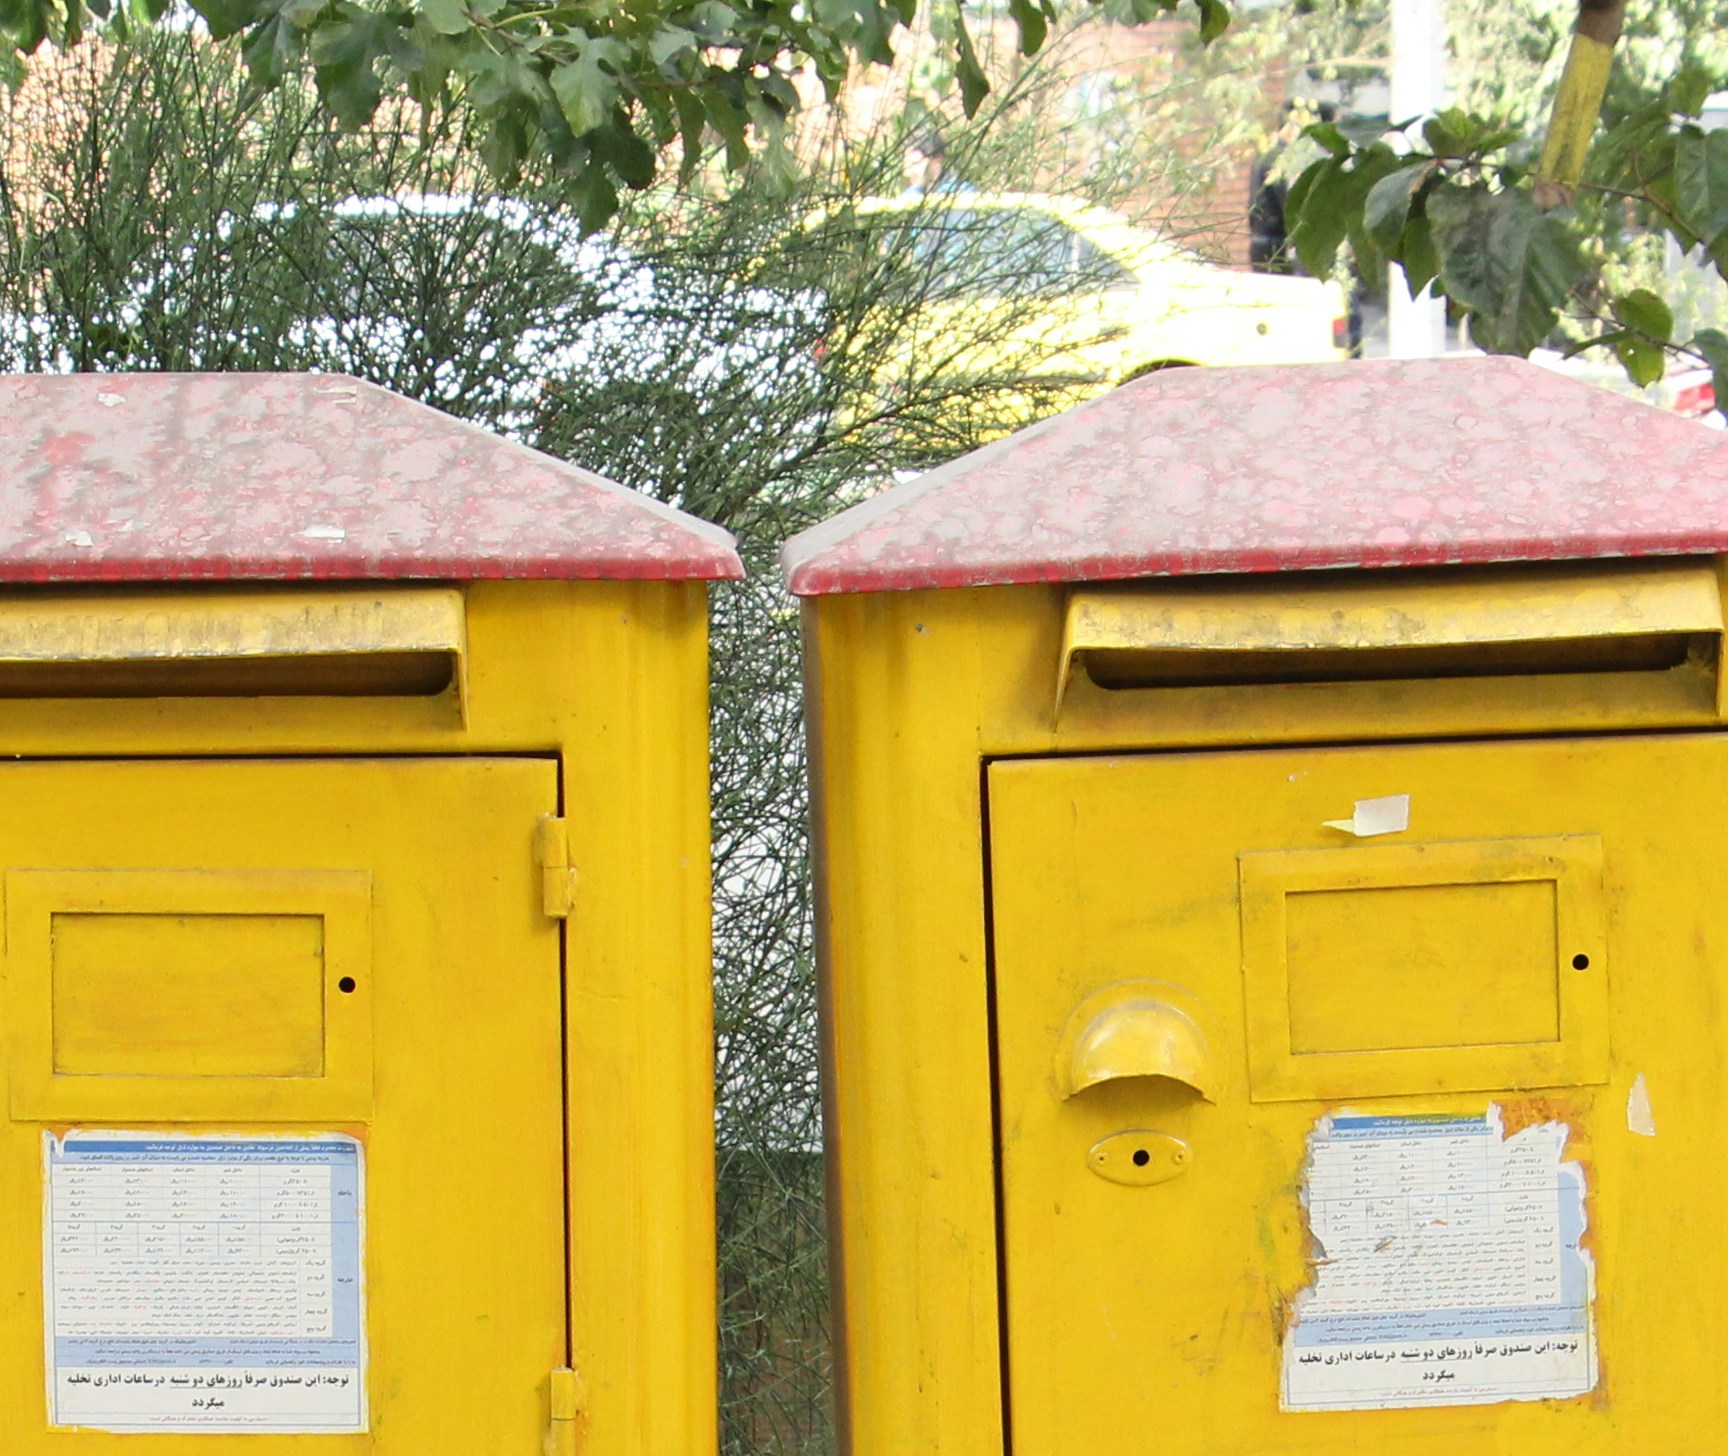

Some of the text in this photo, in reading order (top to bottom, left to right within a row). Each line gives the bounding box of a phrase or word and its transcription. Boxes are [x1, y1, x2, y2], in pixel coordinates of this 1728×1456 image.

[1436, 1346, 1473, 1360] روزهای
[1499, 1343, 1532, 1357] صندوق
[1535, 1341, 1550, 1355] این
[1298, 1351, 1323, 1366] تخلیه
[1324, 1351, 1353, 1365] اداری
[67, 1372, 92, 1387] تخلیه
[93, 1373, 122, 1387] اداری
[206, 1373, 243, 1388] روزهای
[269, 1374, 303, 1388] صندوق
[305, 1373, 321, 1387] این
